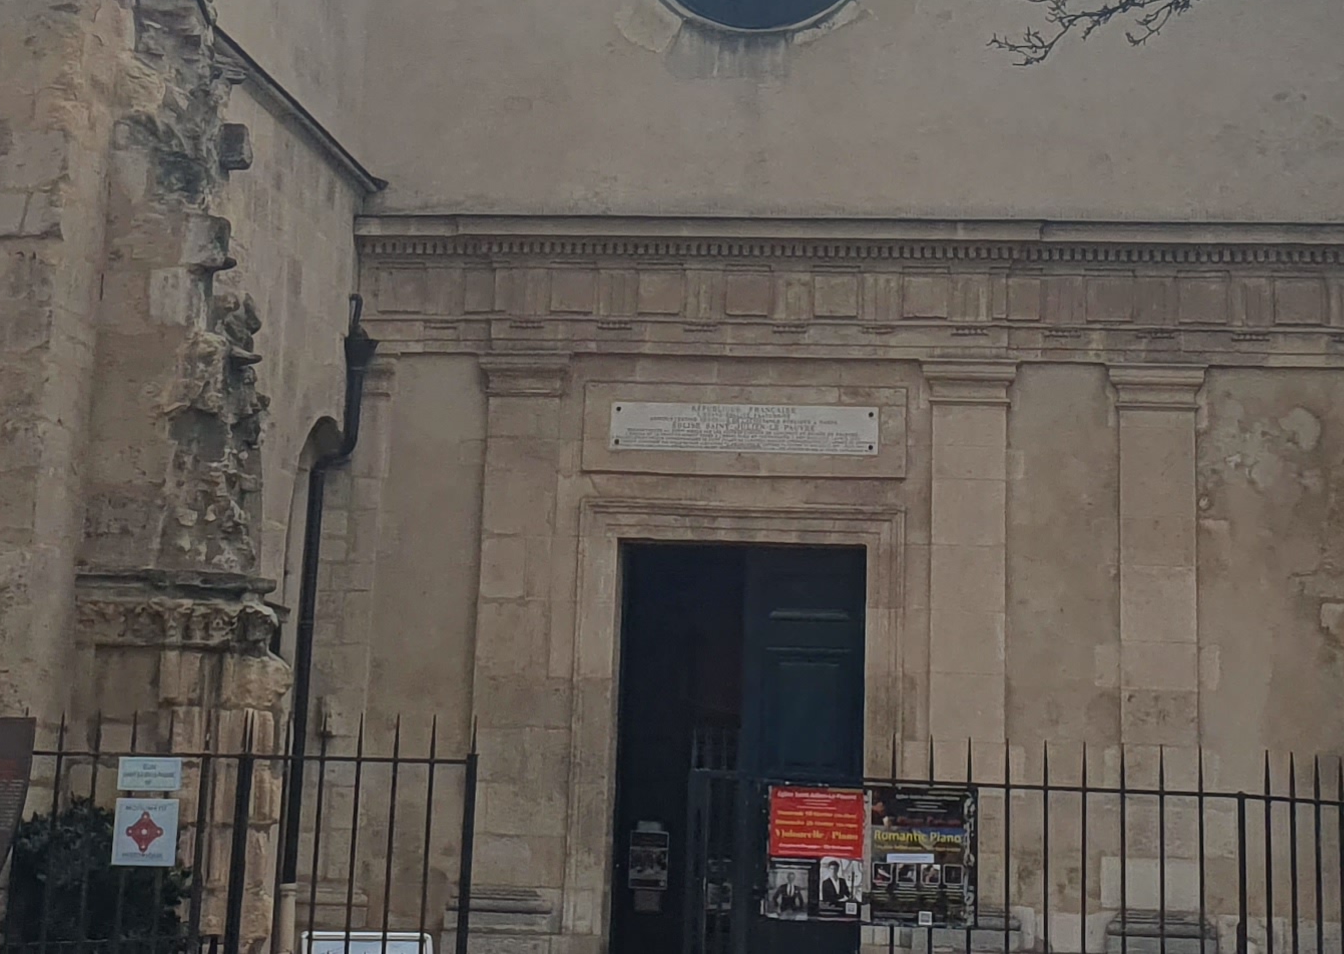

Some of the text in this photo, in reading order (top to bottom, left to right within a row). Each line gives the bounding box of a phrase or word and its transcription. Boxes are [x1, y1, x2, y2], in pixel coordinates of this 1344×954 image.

[832, 831, 859, 841] Piano
[874, 829, 962, 844] Romantic Piano
